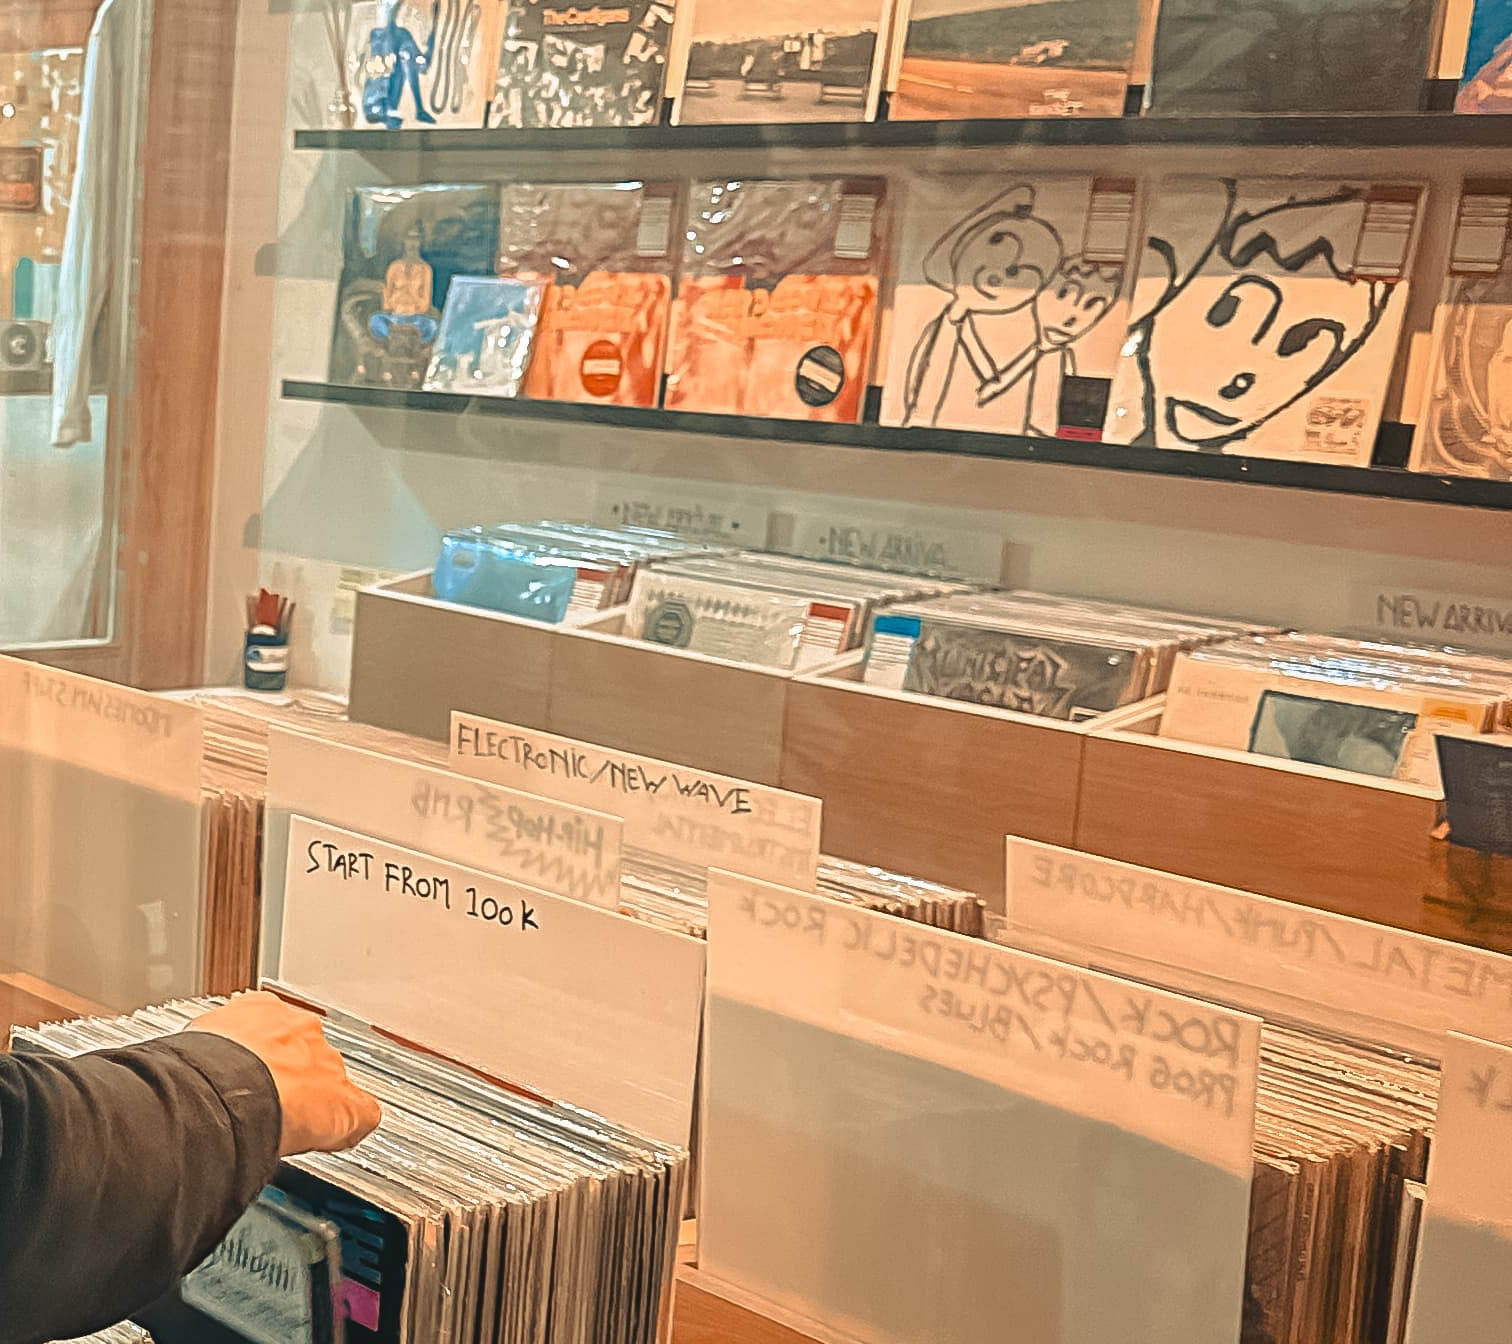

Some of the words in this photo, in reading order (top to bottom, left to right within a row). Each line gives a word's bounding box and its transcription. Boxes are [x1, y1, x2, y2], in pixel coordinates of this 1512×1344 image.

[1376, 593, 1440, 629] NEW
[672, 771, 752, 815] WAVE
[306, 839, 375, 882] START
[384, 861, 451, 905] FROM
